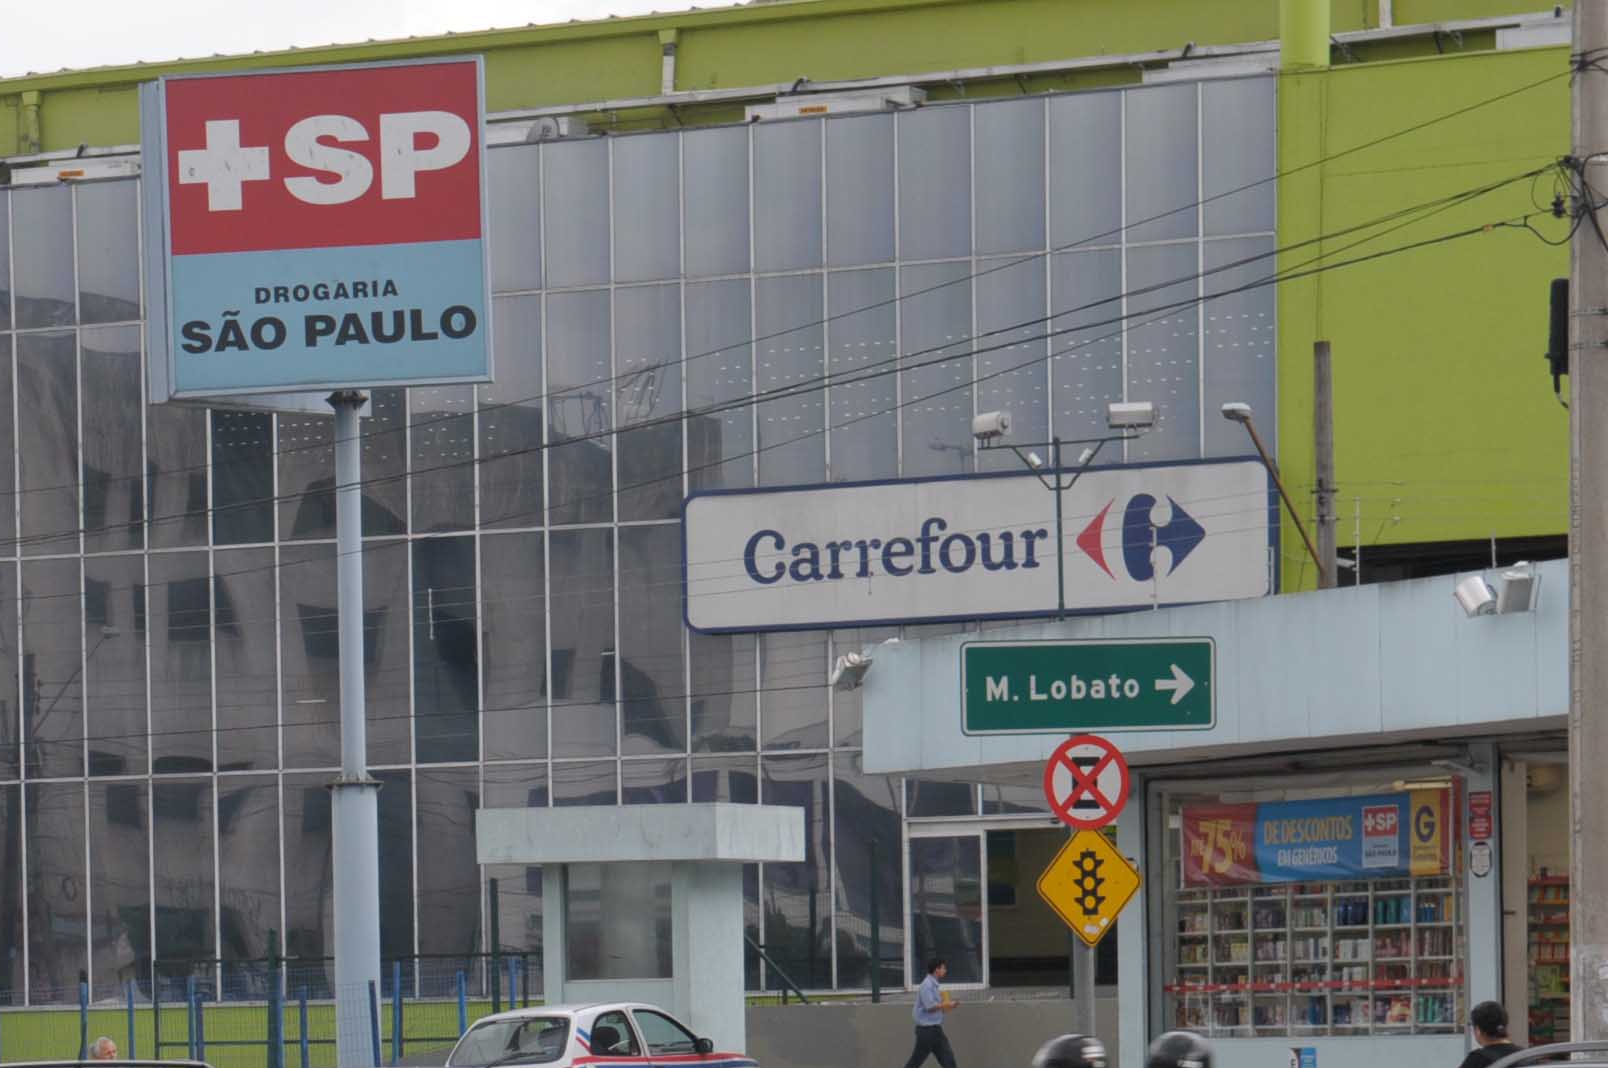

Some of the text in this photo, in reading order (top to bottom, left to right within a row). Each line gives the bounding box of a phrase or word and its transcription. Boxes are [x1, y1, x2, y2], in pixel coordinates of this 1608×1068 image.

[254, 279, 399, 305] DROGARIA
[181, 305, 477, 354] SÃO PAULO
[743, 517, 1048, 585] Carrefour
[984, 673, 1141, 702] M. Lobato
[1263, 815, 1353, 845] DE DESCONTOS
[1415, 805, 1436, 842] G
